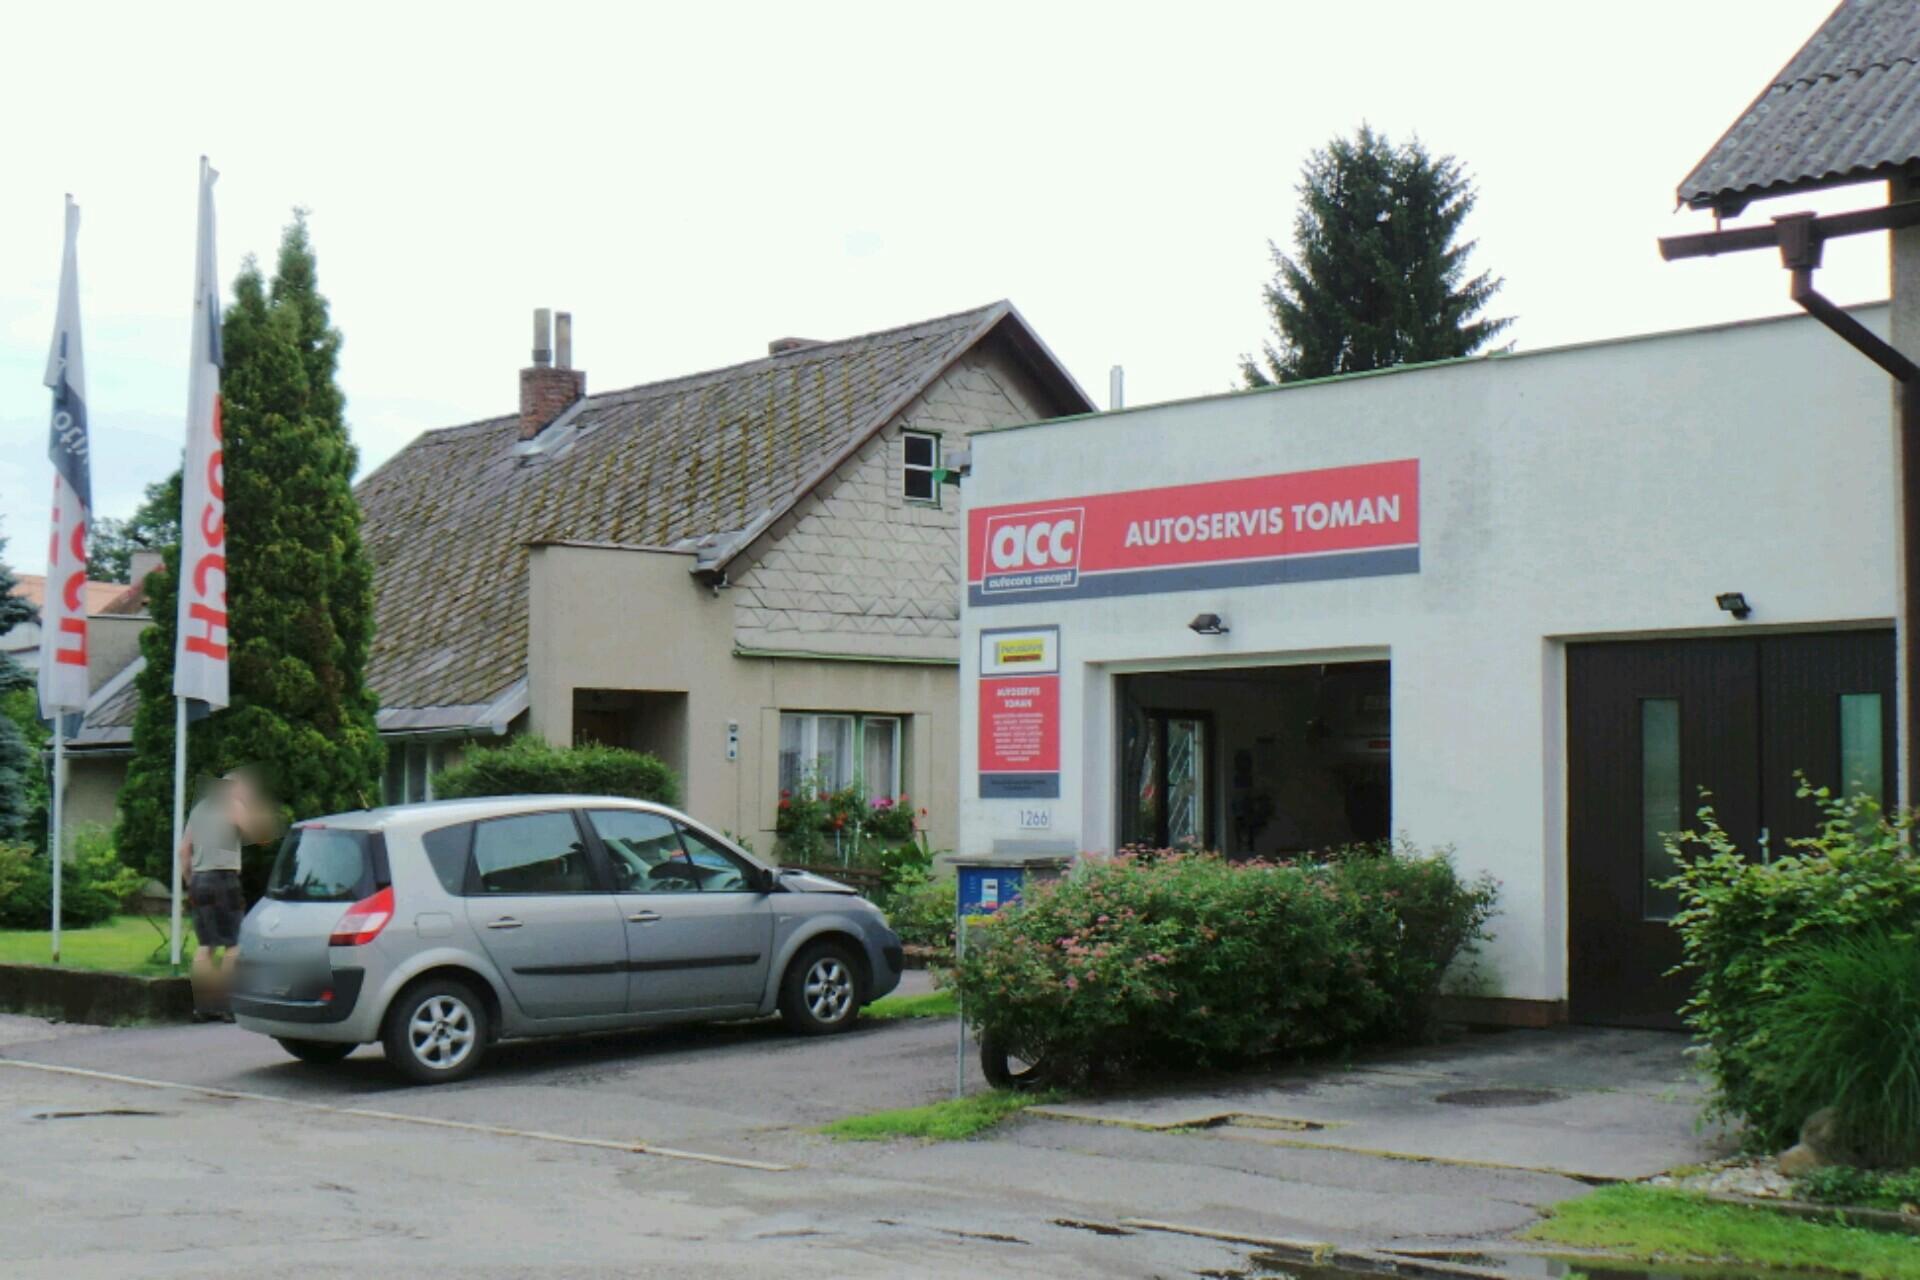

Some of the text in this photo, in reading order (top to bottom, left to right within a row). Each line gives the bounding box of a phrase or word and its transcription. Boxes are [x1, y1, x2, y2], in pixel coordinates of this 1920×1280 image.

[991, 519, 1075, 569] acc
[1125, 495, 1400, 547] AUTOSERVIS TOMAN
[1020, 809, 1048, 826] 1266
